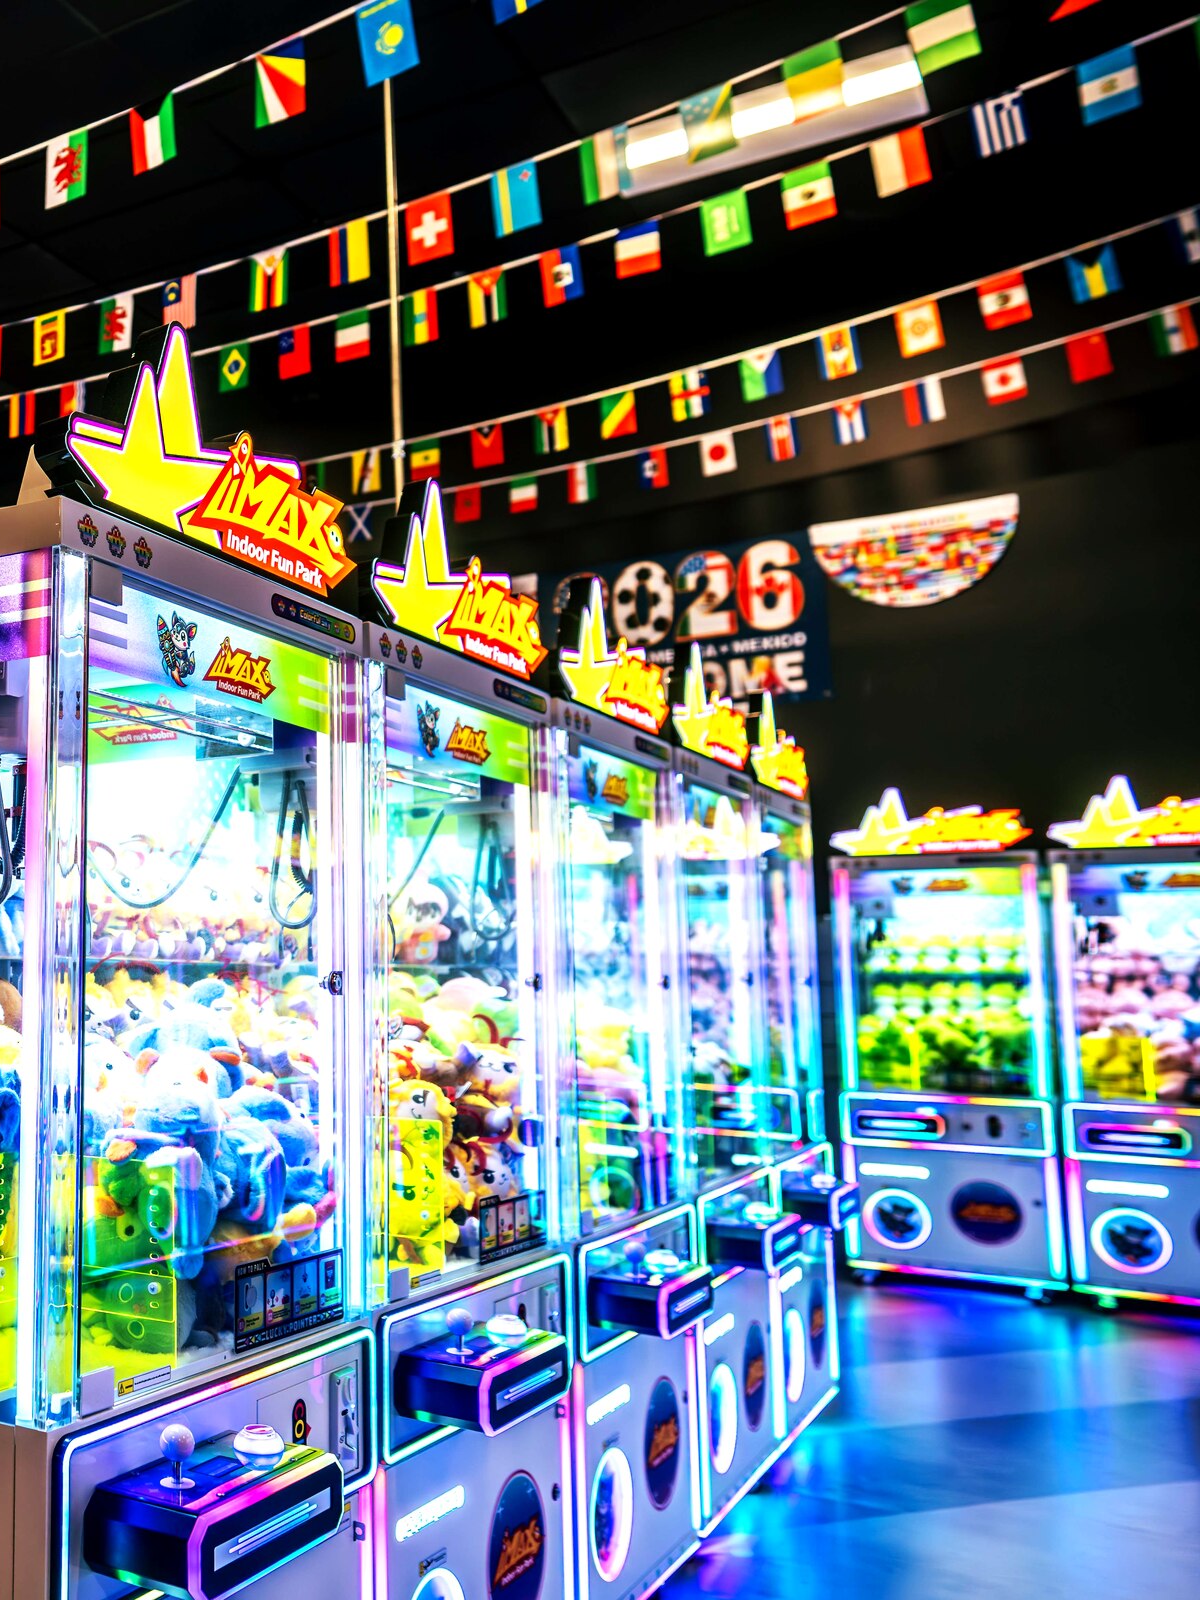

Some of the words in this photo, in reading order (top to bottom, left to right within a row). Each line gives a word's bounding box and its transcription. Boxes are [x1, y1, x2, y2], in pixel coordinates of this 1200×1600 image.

[226, 529, 270, 564] Indoor
[270, 550, 294, 576] Fun
[295, 560, 323, 588] Park
[465, 633, 493, 659] Indoor
[493, 645, 509, 666] Fun
[509, 652, 527, 674] Park
[218, 679, 237, 693] Indoor
[237, 686, 248, 696] Fun
[248, 688, 260, 700] Park
